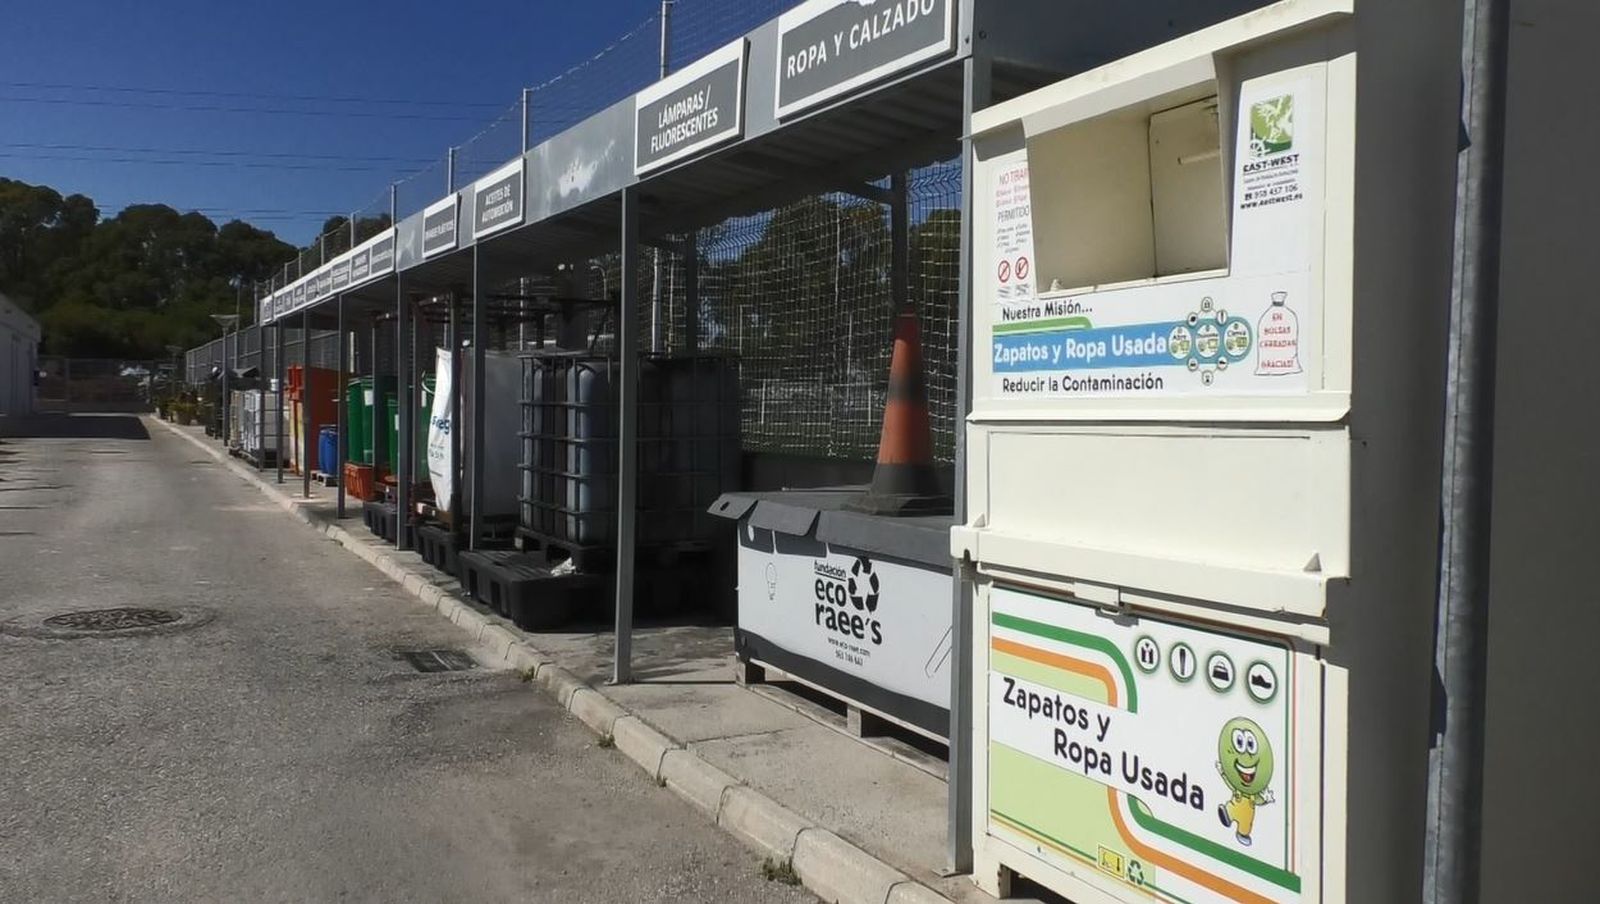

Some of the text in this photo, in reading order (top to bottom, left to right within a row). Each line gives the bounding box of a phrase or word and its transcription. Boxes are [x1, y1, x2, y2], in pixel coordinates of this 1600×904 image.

[787, 0, 935, 79] ROPA Y CALZADO
[658, 90, 704, 129] LÁMPARAS
[650, 106, 718, 154] FLUORESCENTES
[1243, 154, 1300, 172] EAST-WEST
[1002, 299, 1094, 321] Nuestra Misión...
[994, 331, 1167, 367] Zapatos y Ropa Usada
[1003, 371, 1164, 393] Reducir la Contaminación
[815, 578, 847, 607] eco
[815, 602, 882, 646] raee's
[1003, 676, 1111, 742] Zapatos y
[1054, 727, 1205, 812] Ropa Usada
